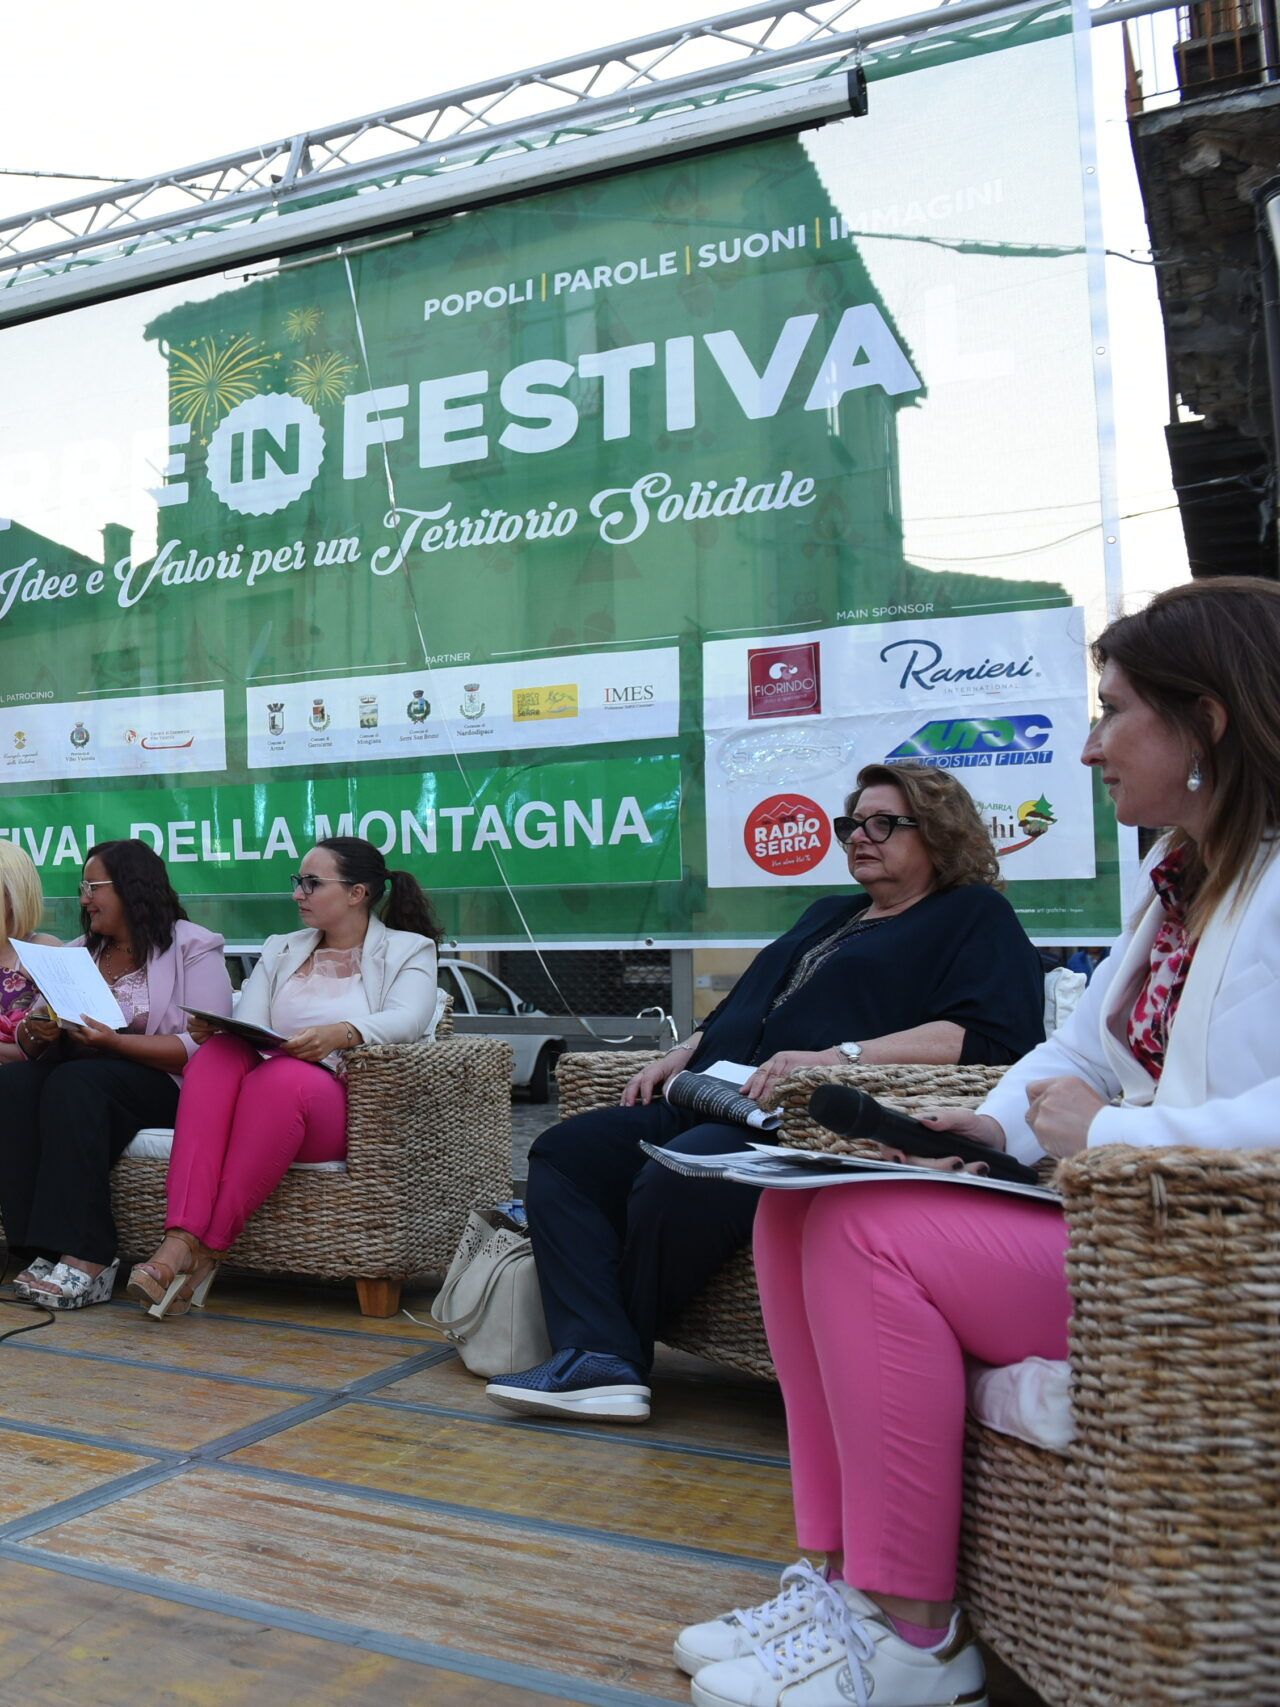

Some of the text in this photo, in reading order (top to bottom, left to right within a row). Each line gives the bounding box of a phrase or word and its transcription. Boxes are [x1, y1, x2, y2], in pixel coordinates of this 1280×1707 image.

[424, 279, 533, 321] POPOLI
[554, 251, 678, 295] PAROLE
[698, 224, 806, 269] SUONI
[230, 423, 300, 484] IN
[86, 570, 105, 594] e
[113, 539, 242, 608] Valori
[246, 541, 306, 586] per
[313, 536, 361, 566] un
[370, 501, 578, 575] Territorio
[589, 470, 817, 545] Solidale
[836, 602, 934, 621] MAIN SPONSOR
[425, 652, 471, 664] PARTNER
[880, 639, 1034, 691] Ranieri
[6, 690, 54, 702] PATROCINIO
[605, 685, 654, 703] IMES
[754, 677, 814, 697] FIORINDO
[944, 682, 1019, 695] INTERNATIONAL
[1000, 751, 1052, 765] FIAT
[975, 800, 1012, 812] ALABRIA
[130, 816, 299, 862] DELLA
[314, 796, 653, 855] MONTAGNA
[755, 834, 821, 857] SERRA
